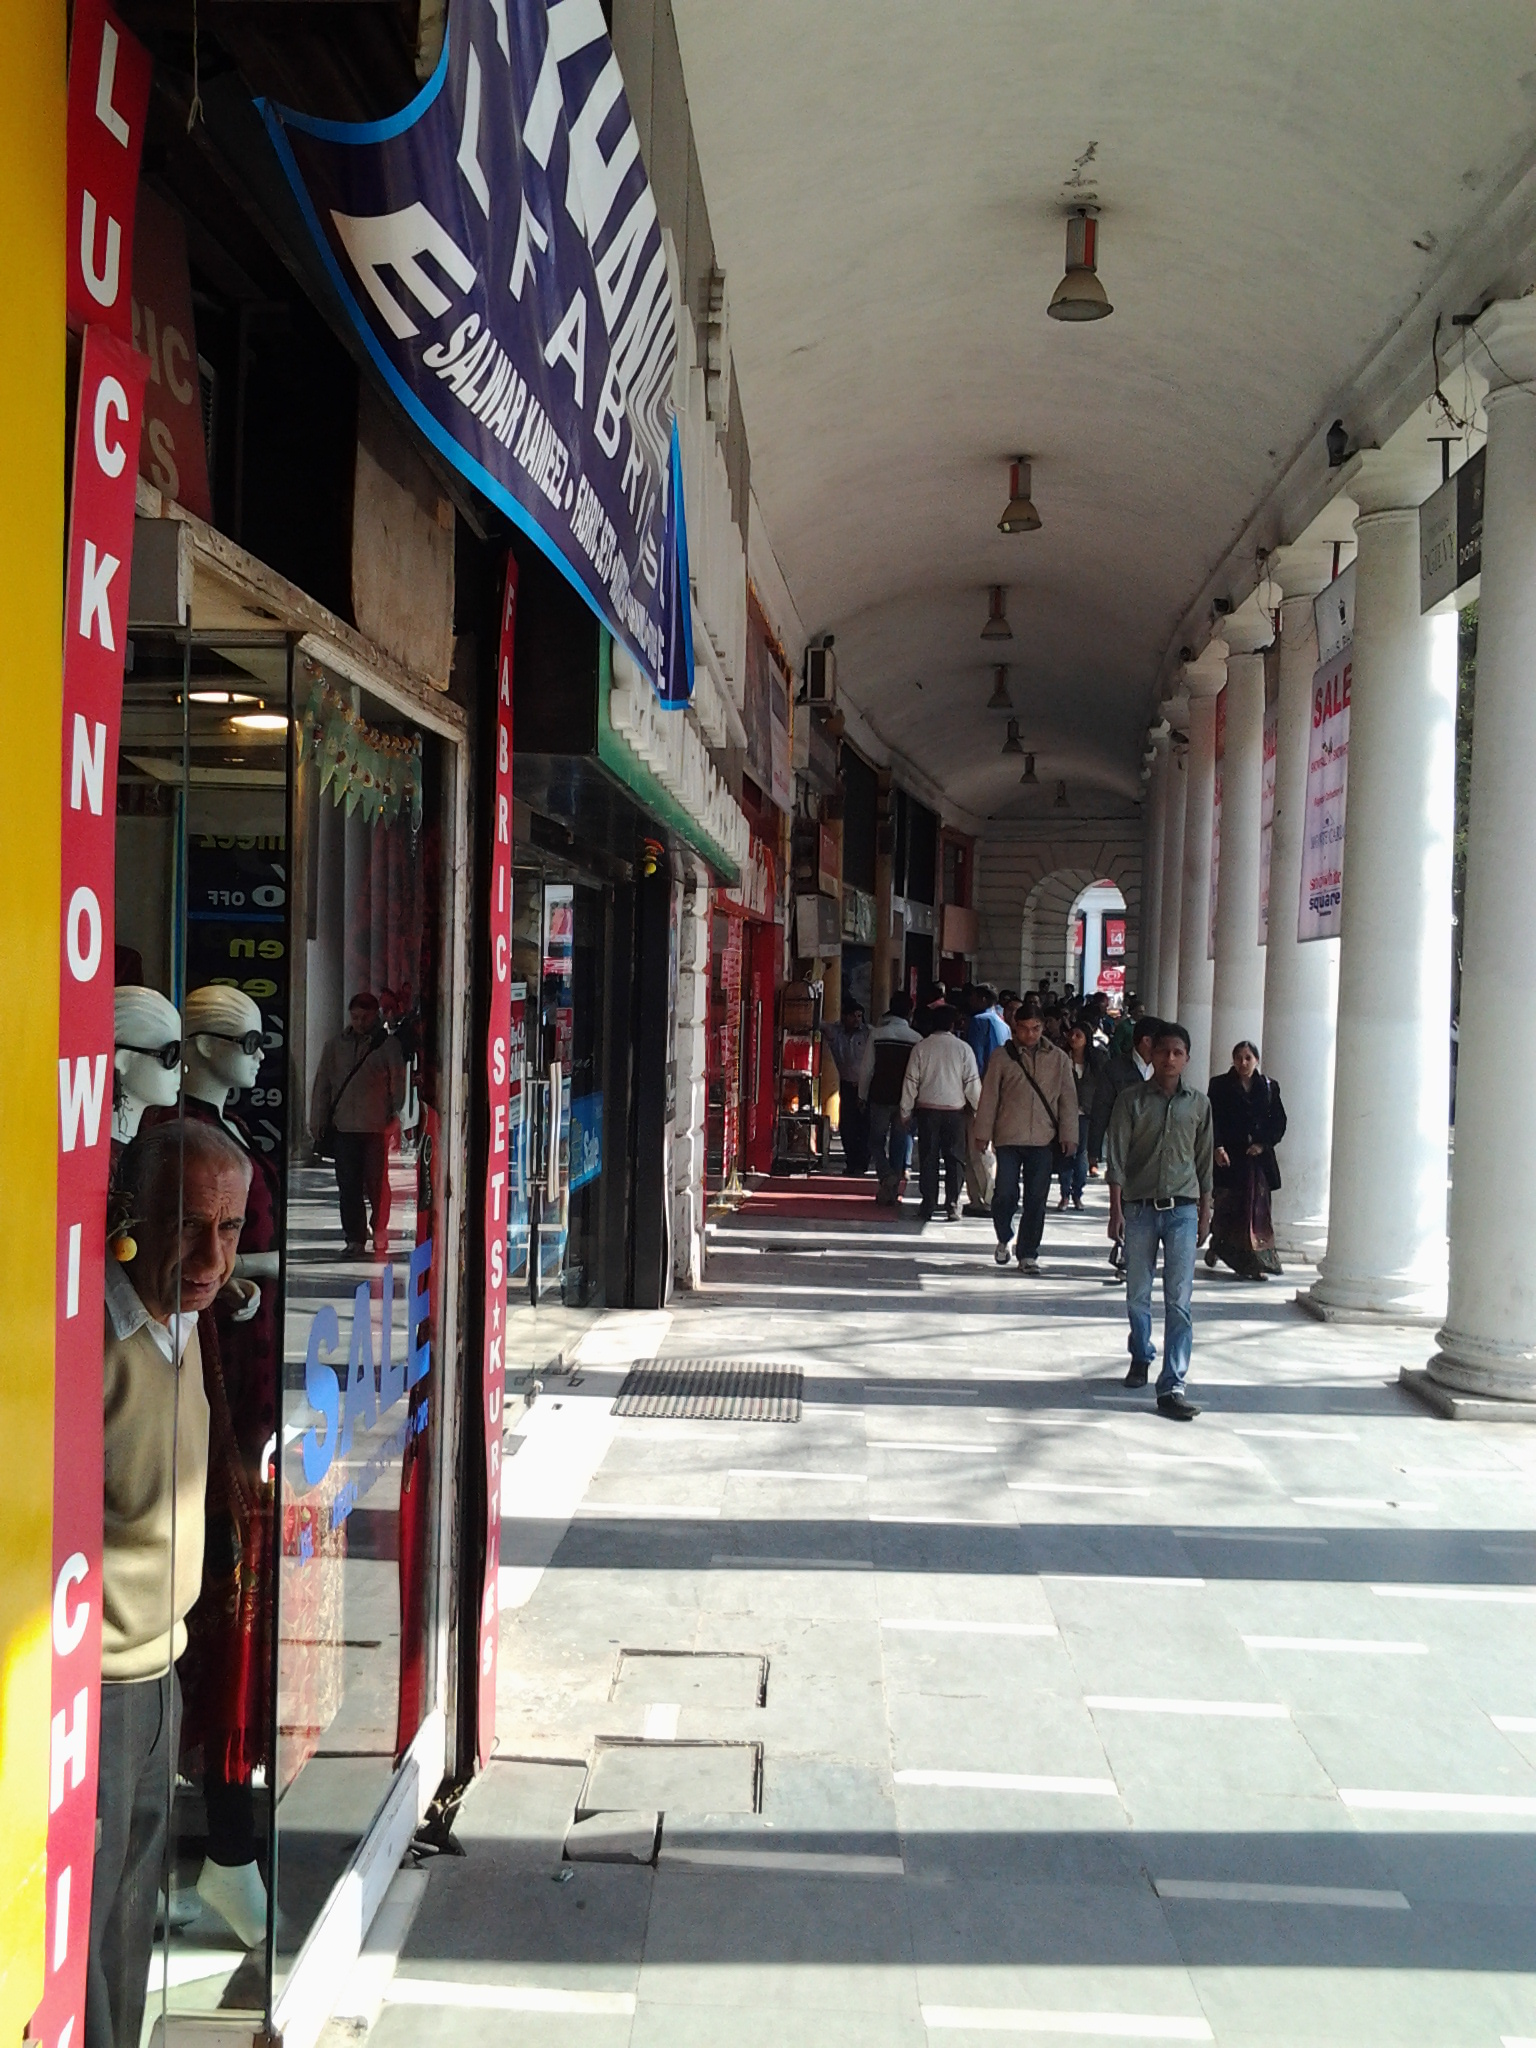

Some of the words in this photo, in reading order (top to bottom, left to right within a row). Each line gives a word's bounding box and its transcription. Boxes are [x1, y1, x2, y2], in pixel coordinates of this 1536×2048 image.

[422, 312, 529, 450] SALWAR
[511, 393, 570, 512] KAMEEZ
[58, 20, 130, 1319] LUCKNOWI
[495, 582, 516, 983] FABRIC
[1313, 662, 1353, 729] SALE
[490, 1037, 506, 1289] SETS
[302, 1237, 433, 1486] SALE
[483, 1340, 504, 1676] KURTIES
